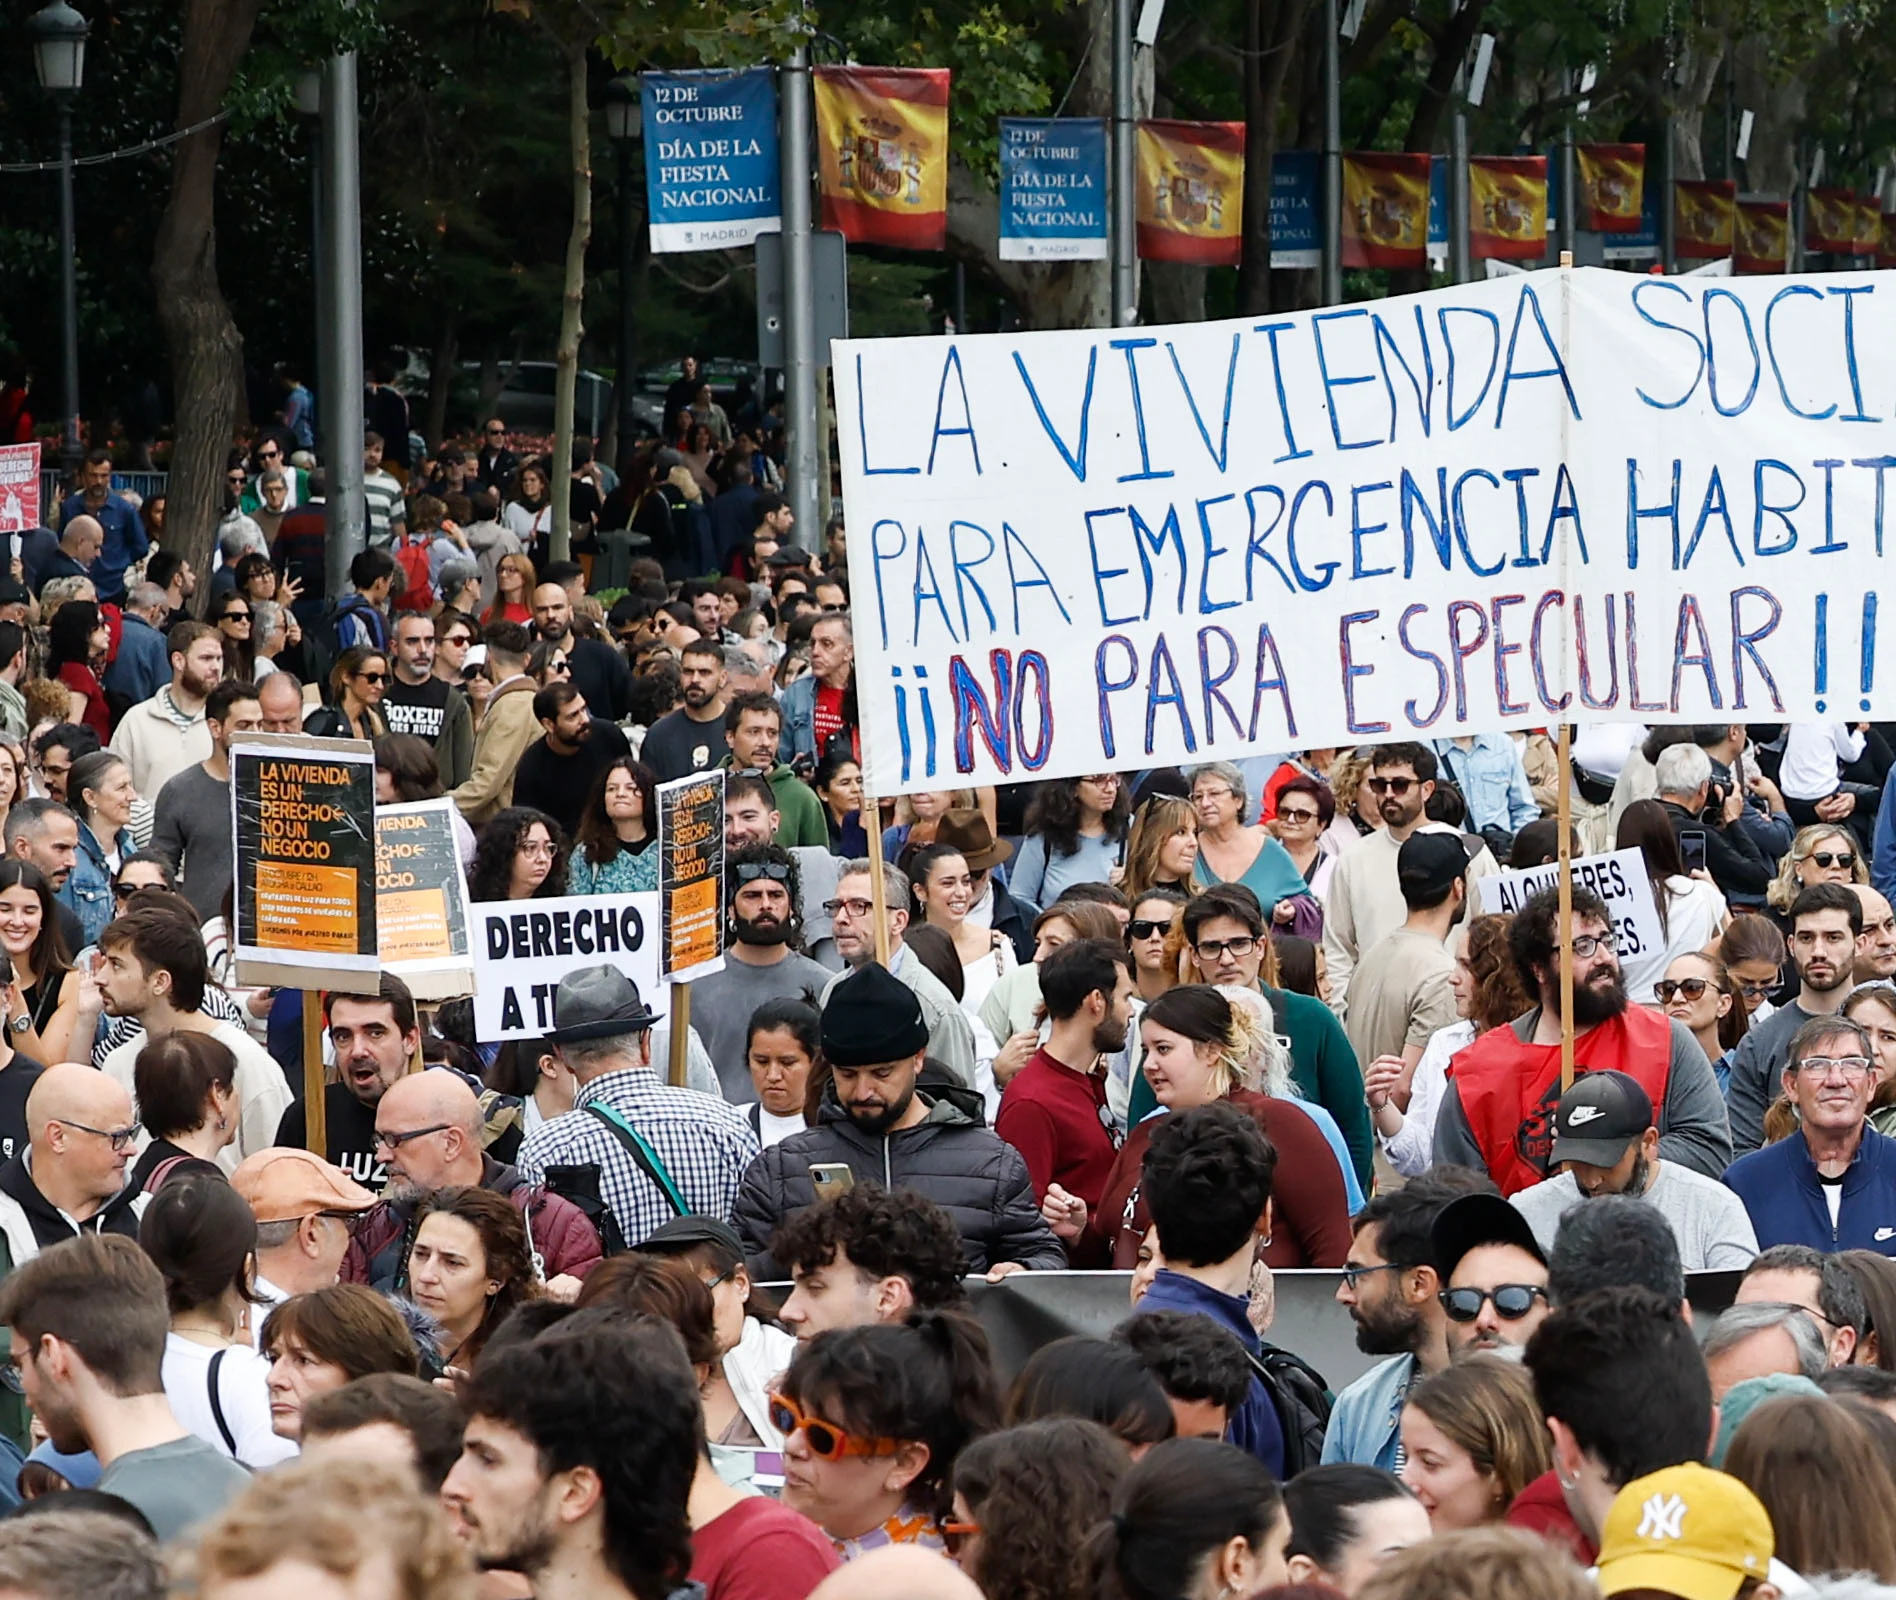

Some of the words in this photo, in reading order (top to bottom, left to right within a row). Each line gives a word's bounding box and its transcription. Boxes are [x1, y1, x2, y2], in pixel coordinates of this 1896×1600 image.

[655, 88, 670, 103] 12
[674, 87, 698, 102] DE
[655, 105, 744, 124] OCTUBRE
[1010, 130, 1021, 142] 12
[1025, 130, 1046, 142] DE
[658, 138, 696, 160] DÍA
[700, 140, 729, 157] DE
[733, 138, 762, 156] LA
[1010, 146, 1080, 160] OCTUBRE
[660, 164, 731, 184] FIESTA
[1012, 170, 1040, 188] DÍA
[1044, 173, 1067, 188] DE
[1070, 173, 1093, 188] LA
[662, 187, 771, 208] NACIONAL
[1012, 192, 1067, 207] FIESTA
[1011, 211, 1100, 227] NACIONAL
[700, 229, 748, 241] MADRID
[856, 345, 983, 477] LA
[1013, 285, 1581, 482] VIVIENDA
[872, 519, 1071, 648] PARA
[1090, 460, 1588, 628] EMERGENCIA
[1096, 622, 1298, 761] PARA
[390, 721, 409, 733] DES
[413, 723, 439, 736] RUES
[259, 762, 279, 780] LA
[281, 763, 351, 786] VIVIENDA
[260, 781, 280, 798] ES
[281, 782, 303, 800] UN
[260, 800, 332, 822] DERECHO
[260, 819, 285, 838] NO
[286, 821, 308, 840] UN
[376, 816, 428, 832] VIENDA
[673, 822, 707, 845] DERECHO
[260, 838, 331, 860] NEGOCIO
[673, 848, 685, 864] NO
[686, 846, 697, 862] UN
[376, 872, 415, 889] OCIO
[673, 859, 706, 882] NEGOCIO
[485, 906, 644, 960] DERECHO
[501, 986, 525, 1031] A
[1636, 1492, 1688, 1540] NY
